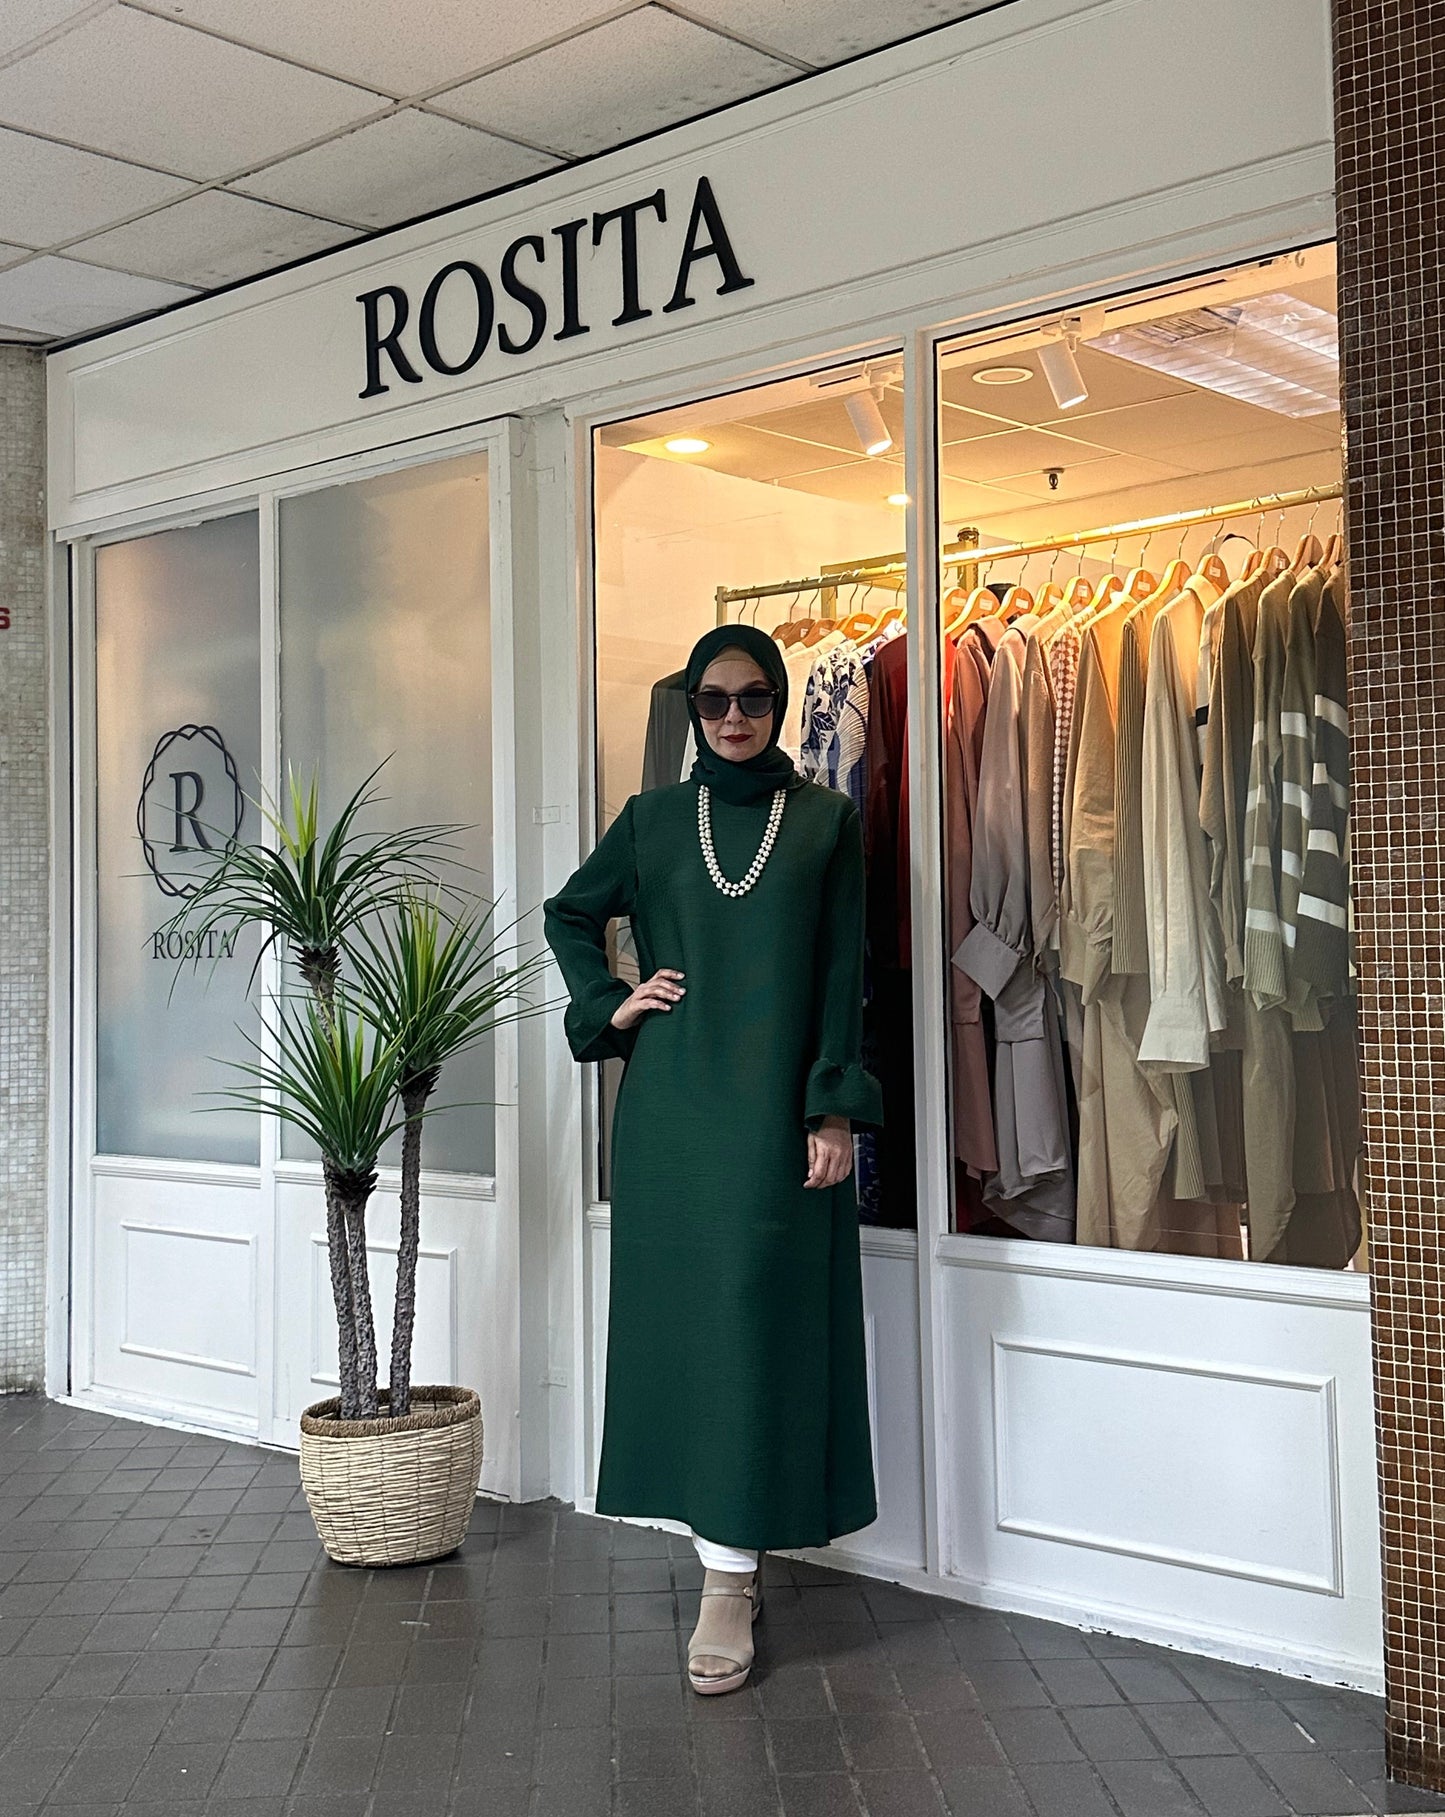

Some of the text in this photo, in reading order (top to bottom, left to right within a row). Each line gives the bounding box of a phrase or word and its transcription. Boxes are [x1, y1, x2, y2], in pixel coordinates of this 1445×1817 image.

[356, 175, 755, 399] ROSITA
[169, 771, 213, 852] R
[152, 930, 233, 959] ROSITA
